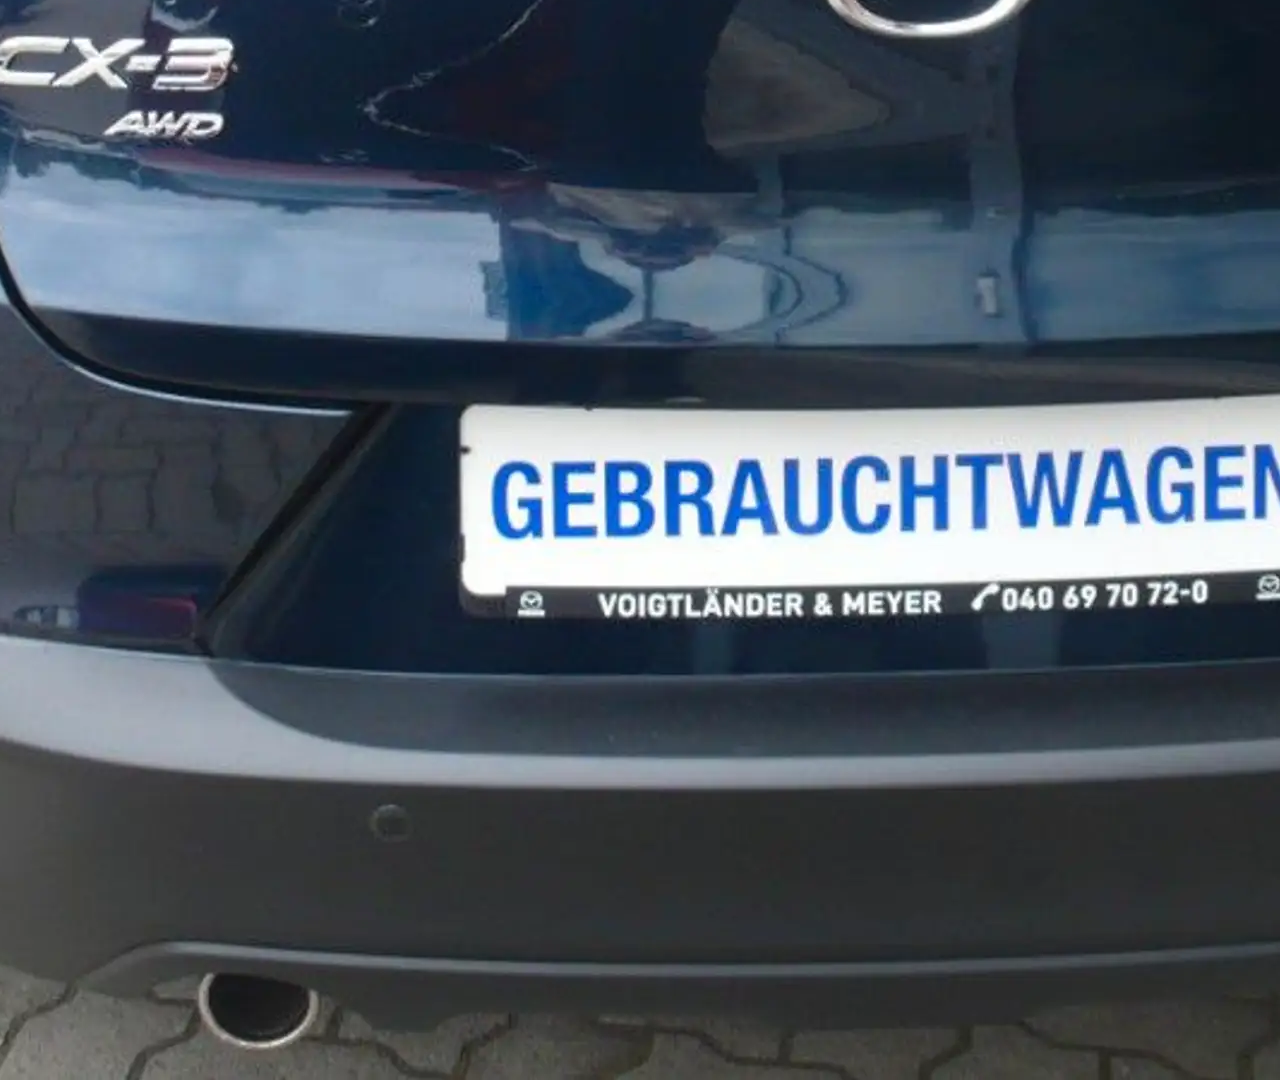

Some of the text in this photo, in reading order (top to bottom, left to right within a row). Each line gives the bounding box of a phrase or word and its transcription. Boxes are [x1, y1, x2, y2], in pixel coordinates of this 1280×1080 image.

[103, 110, 224, 139] AWD
[598, 579, 1208, 618] VOIGTLÄNDER & MEYER 040 69 70 72-0
